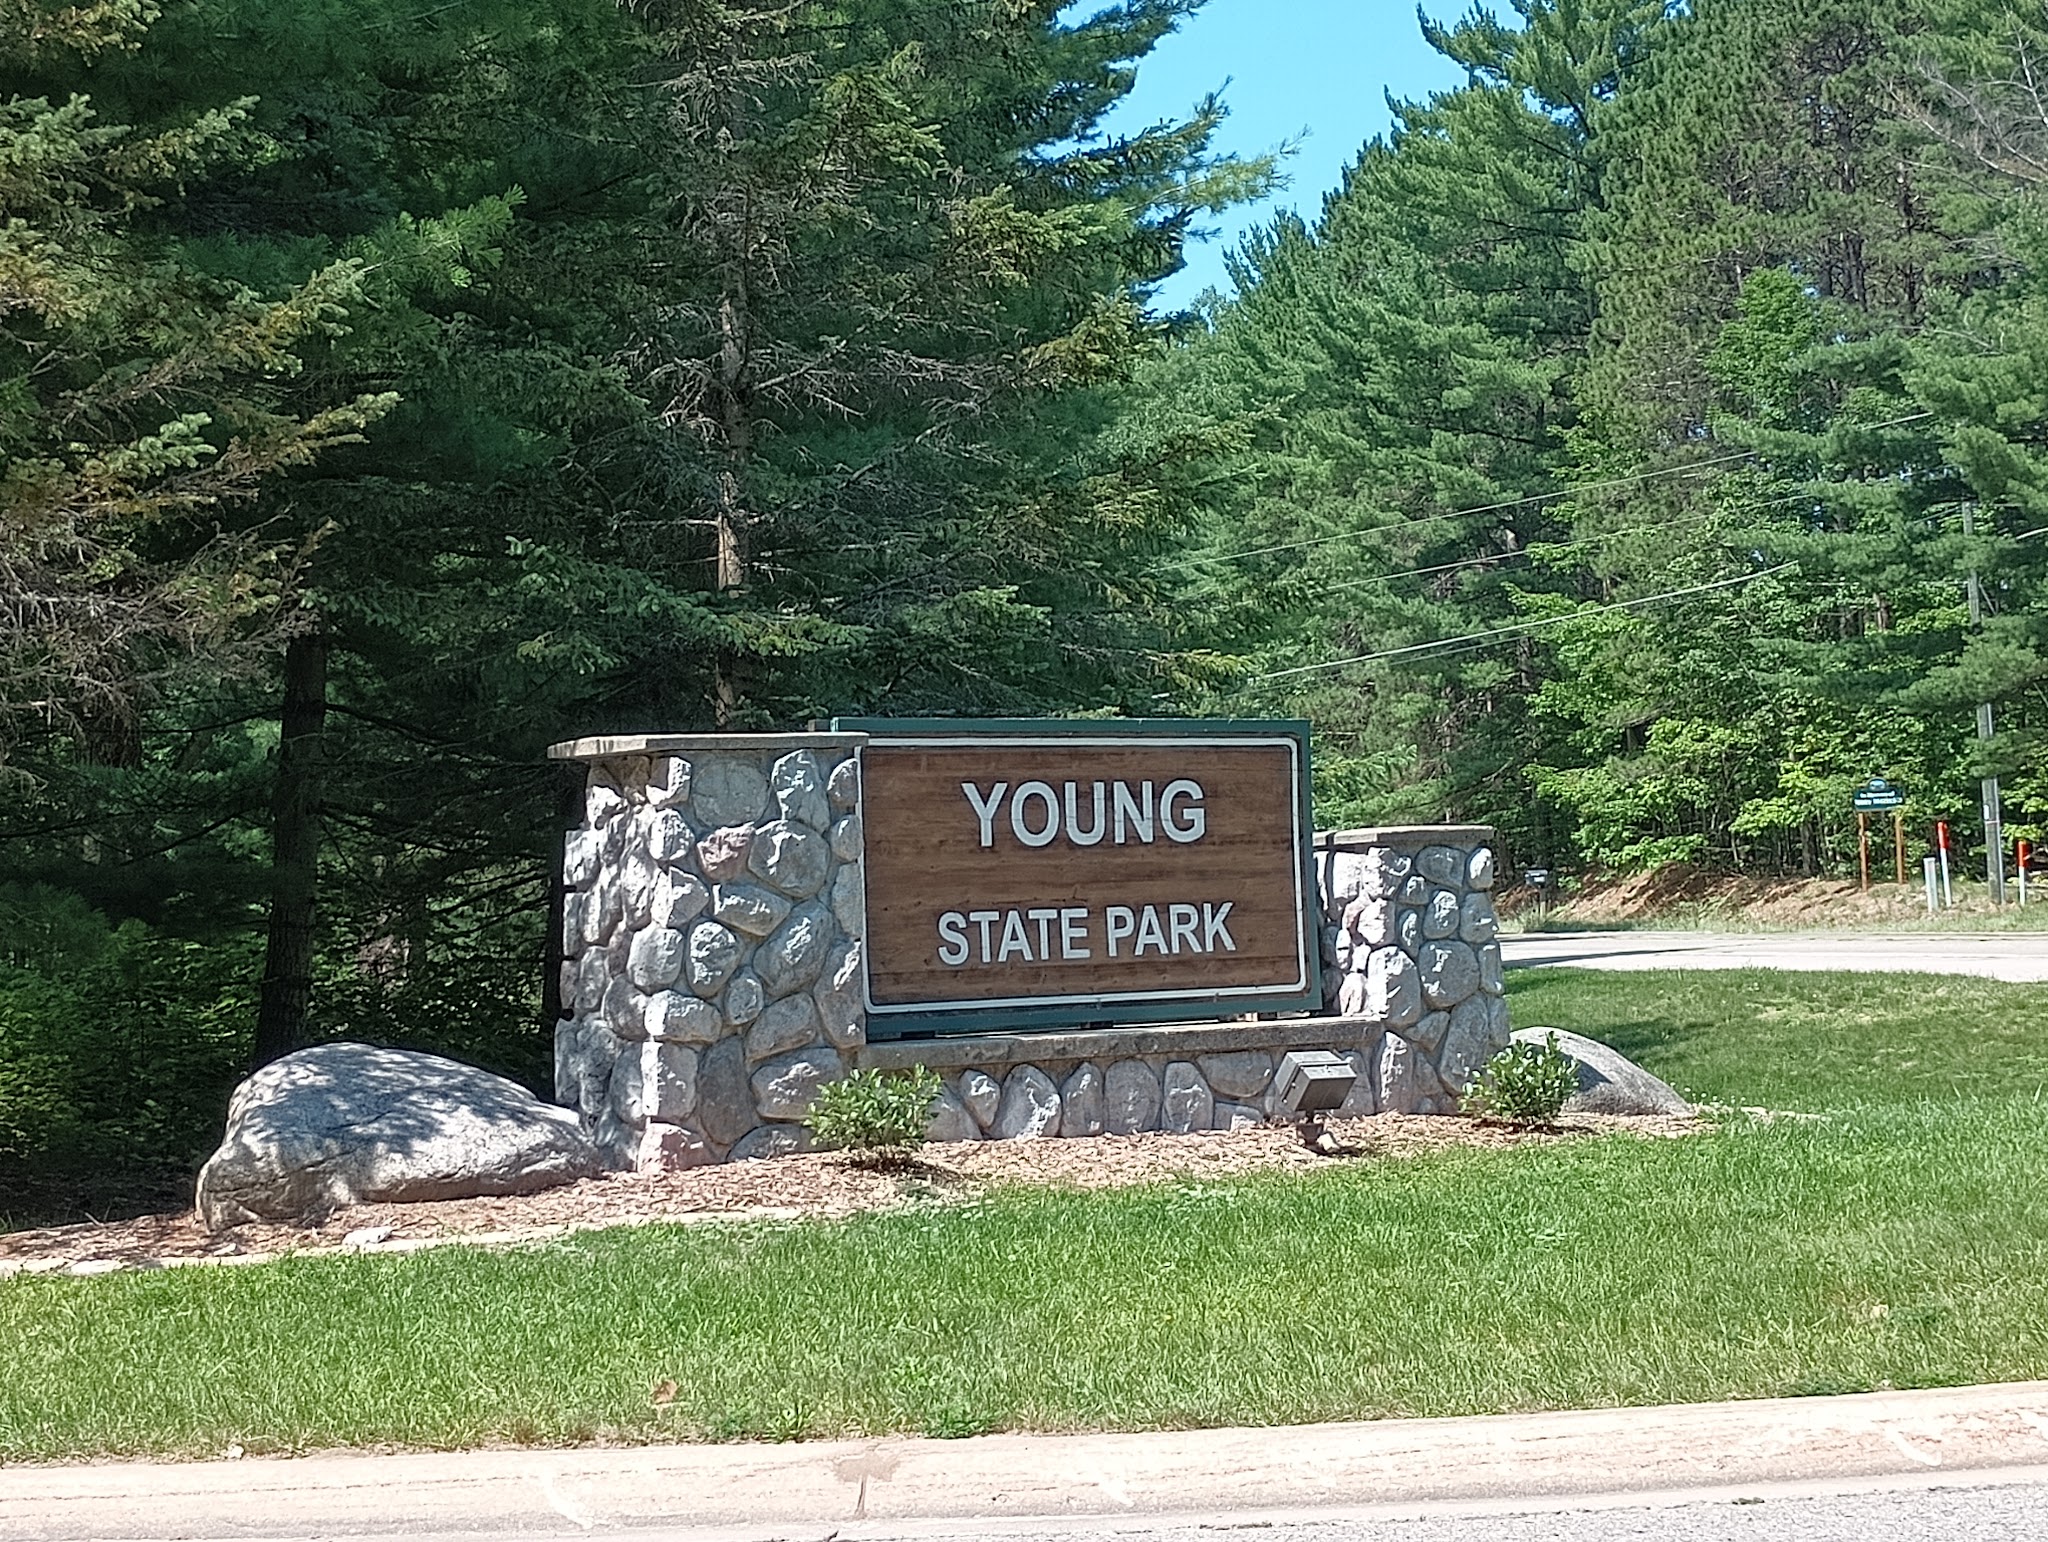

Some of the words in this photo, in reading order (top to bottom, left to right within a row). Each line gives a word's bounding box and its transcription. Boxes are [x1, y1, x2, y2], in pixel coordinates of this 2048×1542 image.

[961, 780, 1206, 847] YOUNG
[938, 908, 1091, 965] STATE
[1106, 902, 1236, 957] PARK
